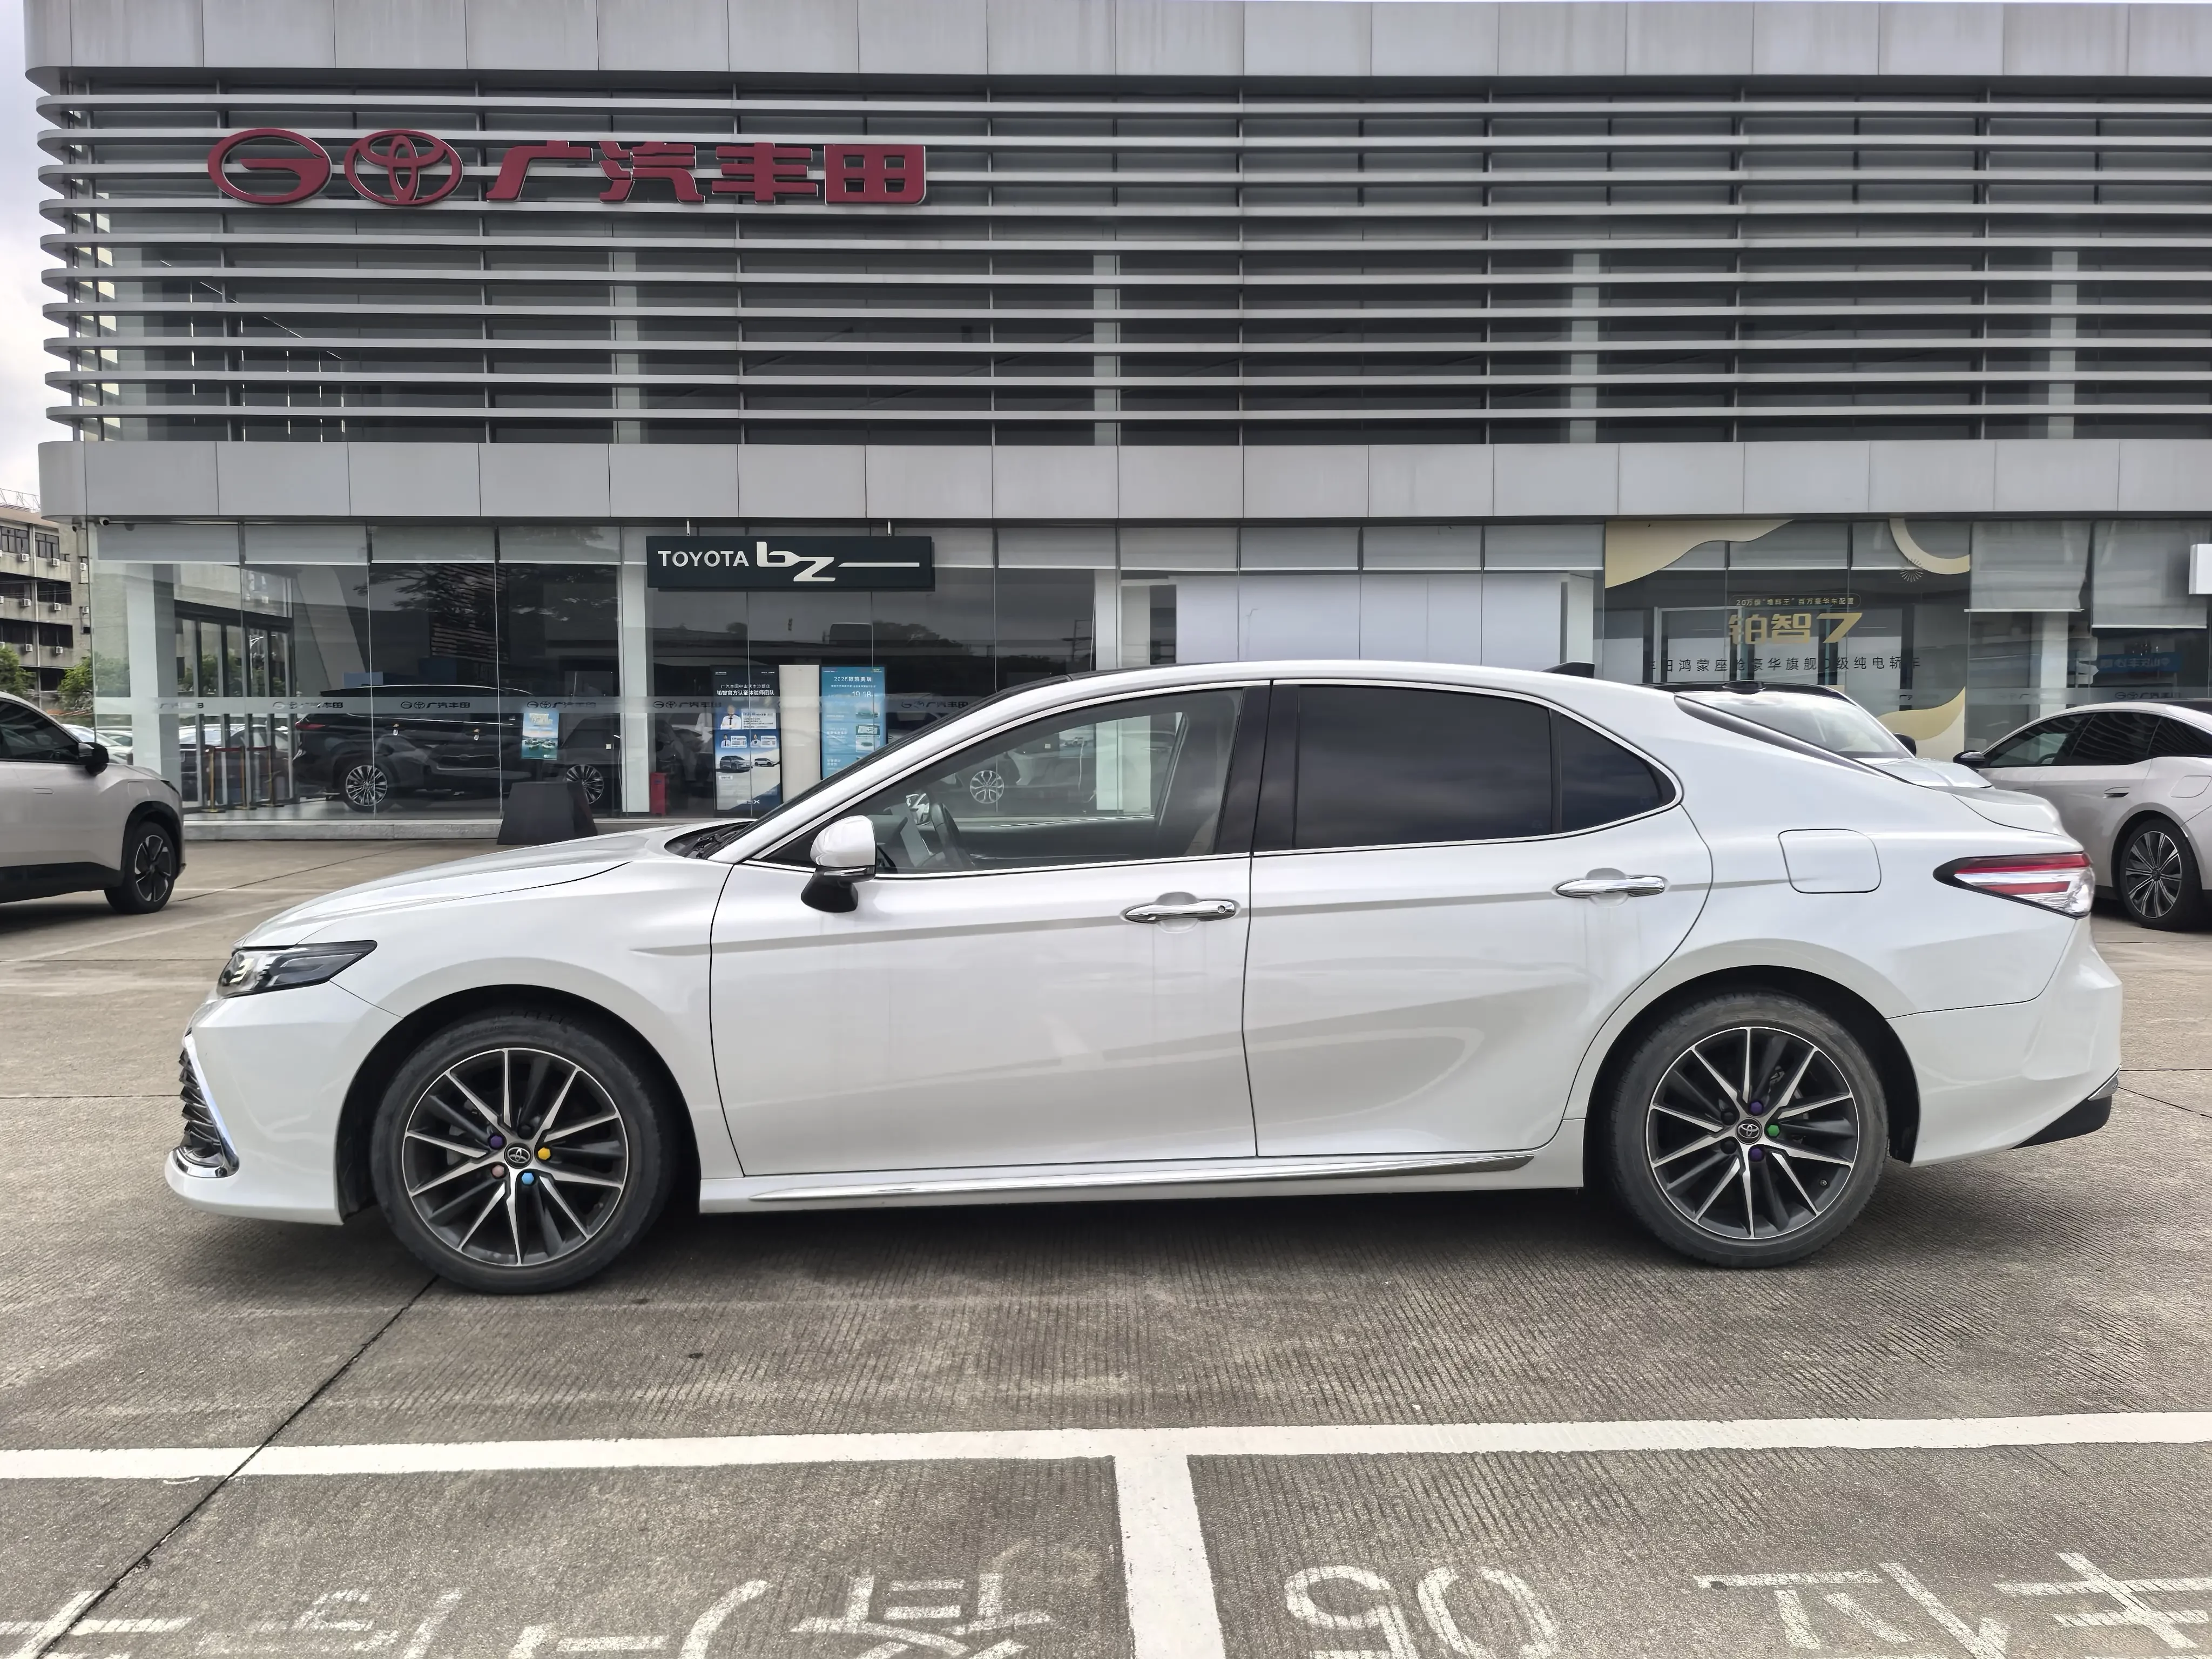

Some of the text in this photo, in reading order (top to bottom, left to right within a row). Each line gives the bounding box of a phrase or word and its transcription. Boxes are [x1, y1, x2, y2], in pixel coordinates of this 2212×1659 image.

[485, 139, 927, 205] 广汽丰田
[657, 550, 750, 567] TOYOTA
[1729, 612, 1863, 645] 铂智7
